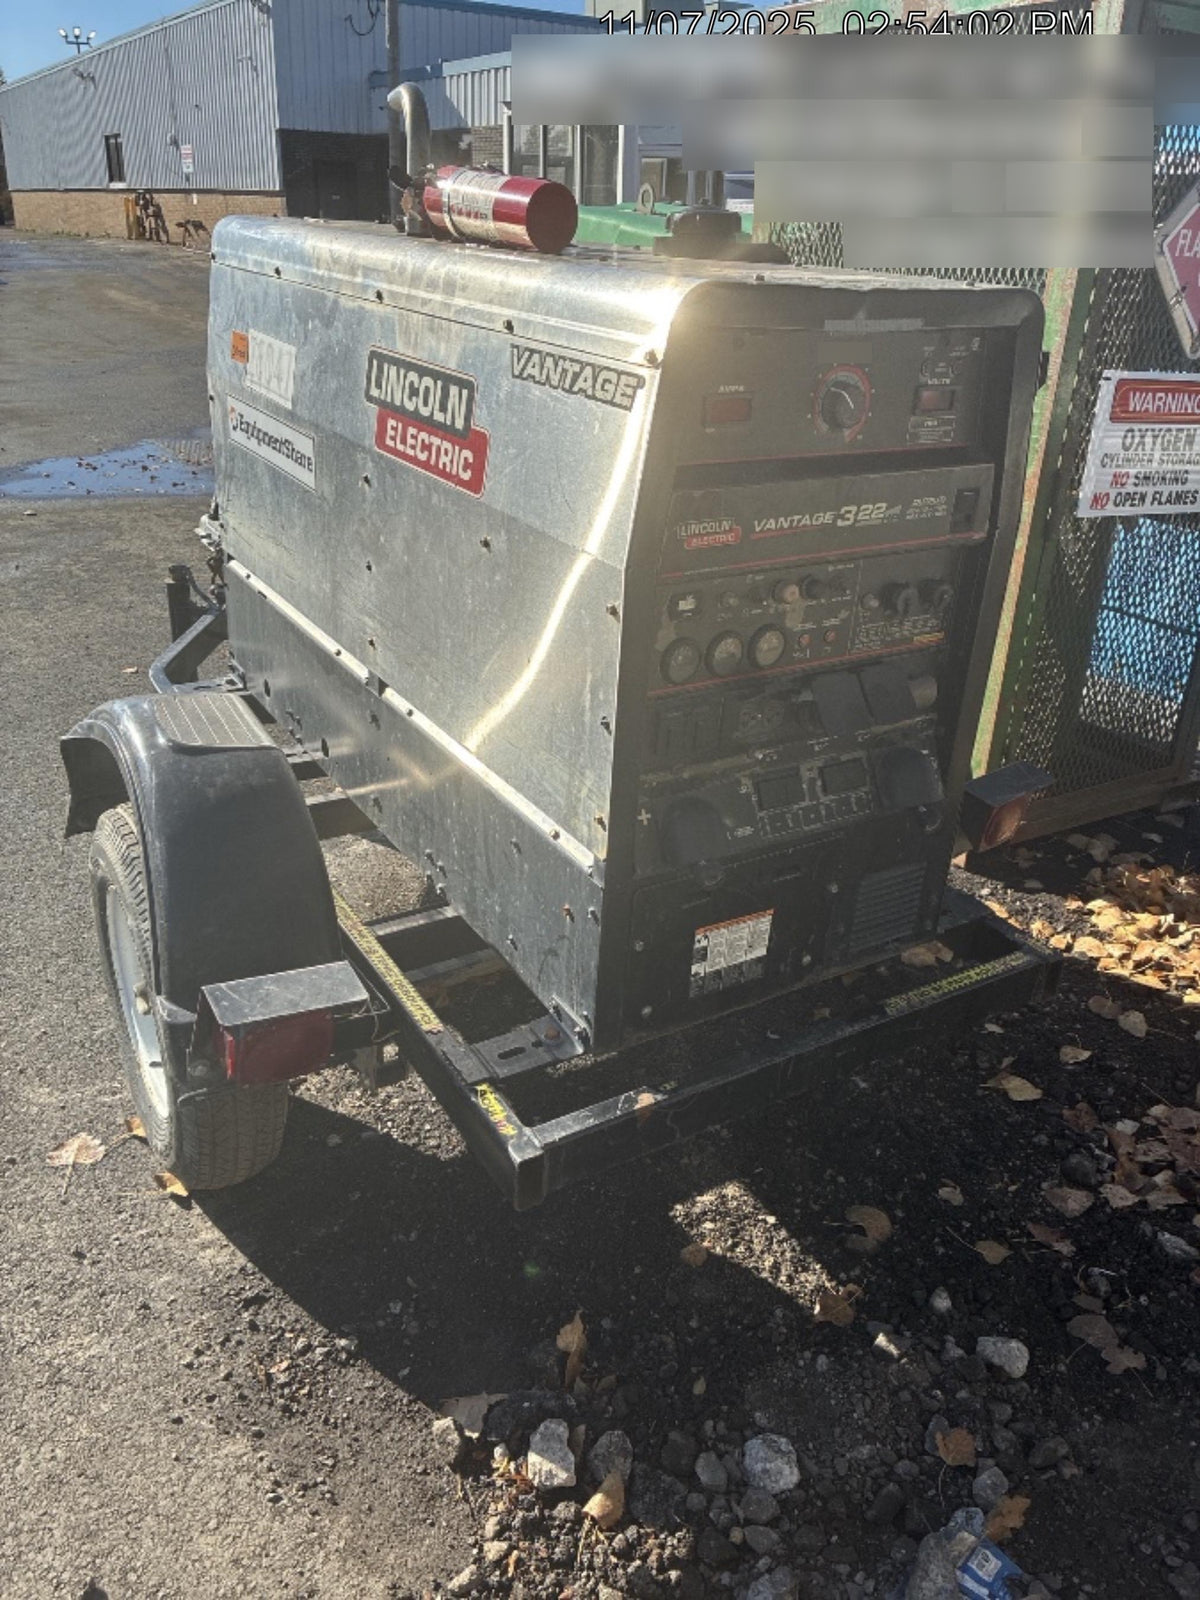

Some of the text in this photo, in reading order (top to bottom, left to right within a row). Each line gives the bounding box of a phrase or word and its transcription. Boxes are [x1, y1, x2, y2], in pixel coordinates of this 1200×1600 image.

[511, 345, 640, 411] VANTAGE
[369, 358, 468, 430] LINCOLN
[385, 418, 474, 481] ELECTRIC
[1121, 427, 1197, 453] OXYGEN
[1101, 453, 1153, 468] CYLINDER
[1110, 470, 1190, 488] NO SMOKING
[1089, 490, 1200, 510] NO OPEN FLAMES
[680, 519, 732, 536] LINCOLN
[754, 512, 836, 533] VANTAGE
[837, 502, 888, 526] 322
